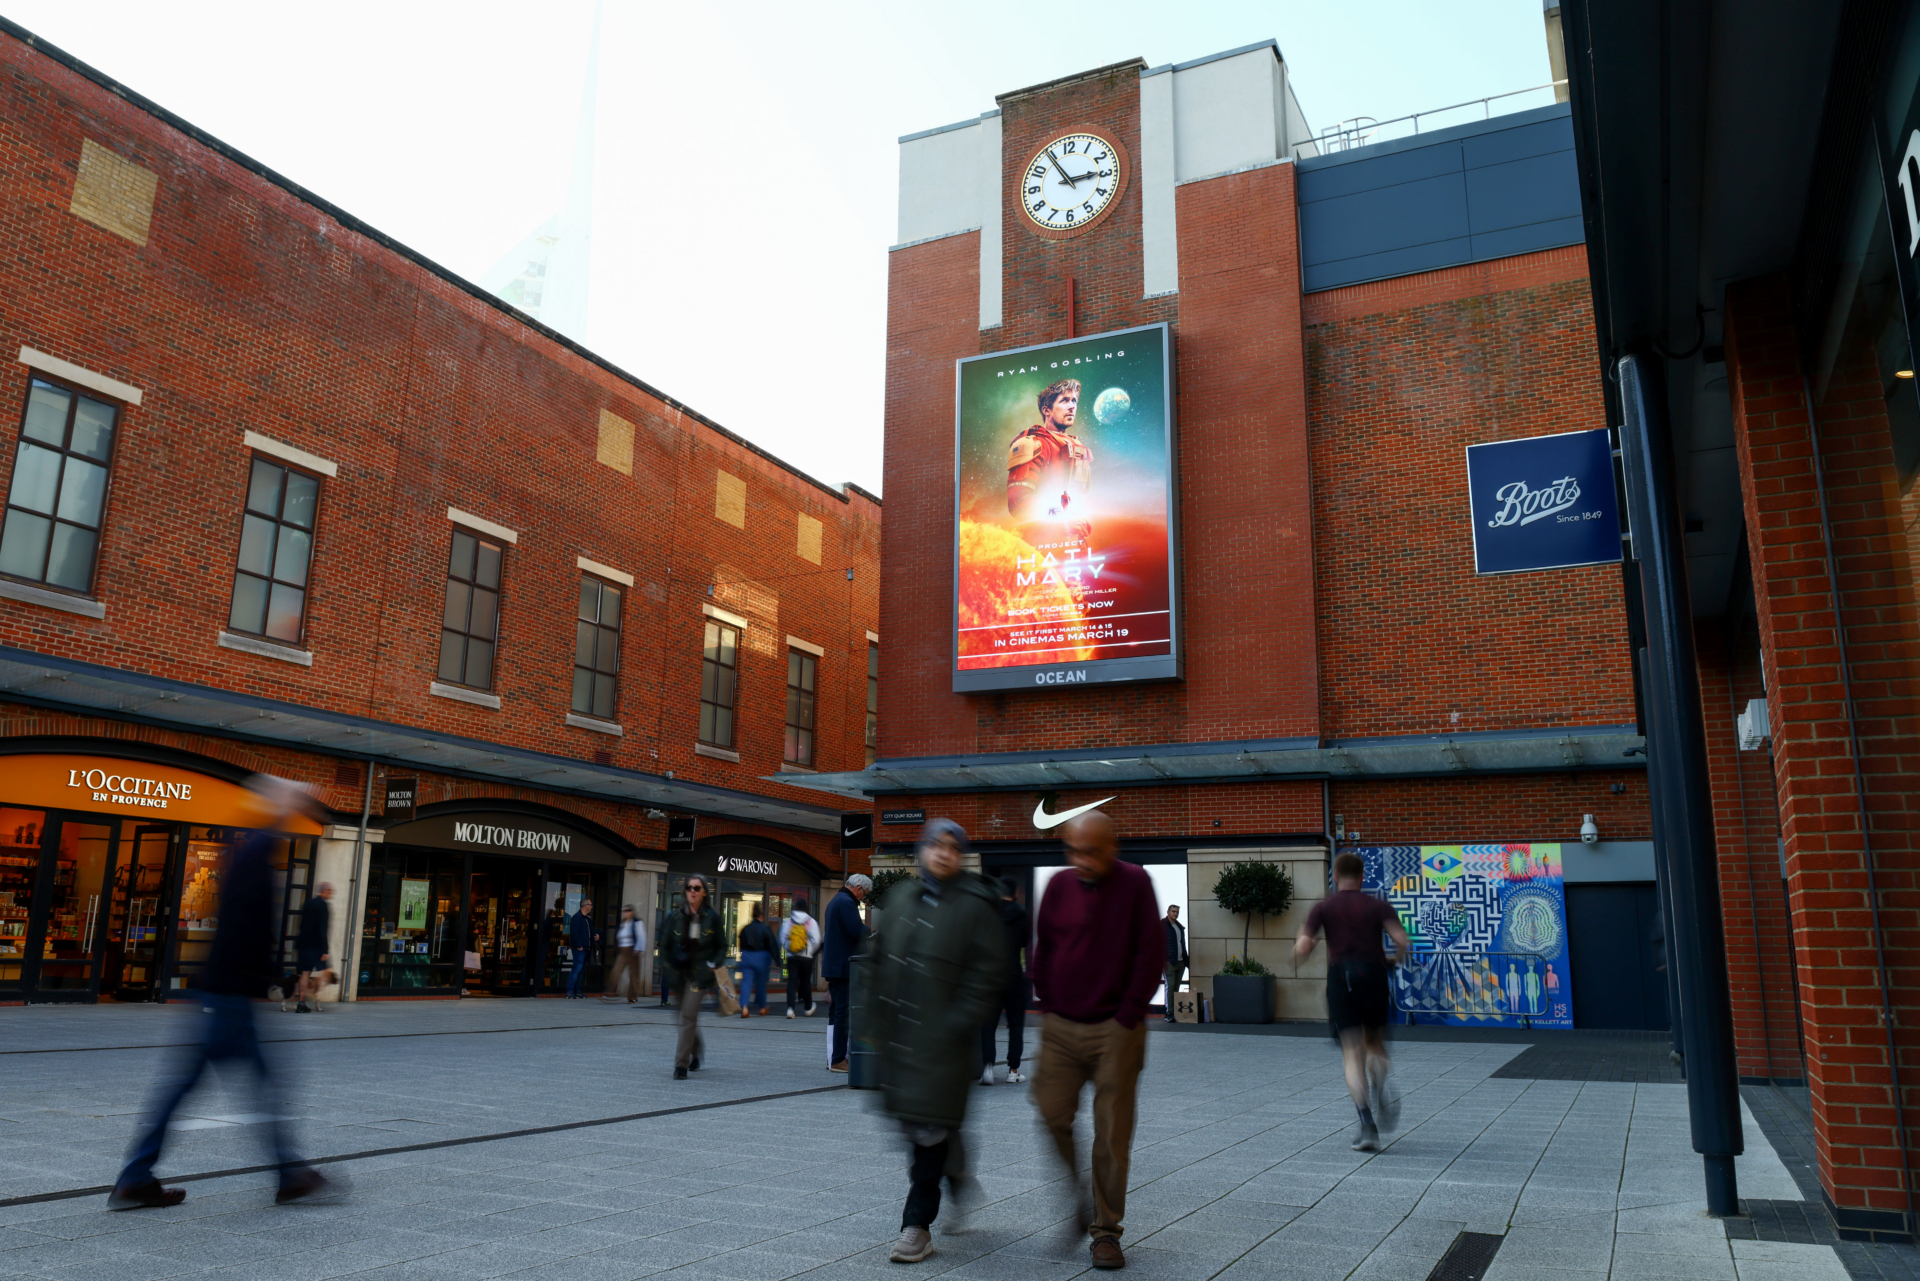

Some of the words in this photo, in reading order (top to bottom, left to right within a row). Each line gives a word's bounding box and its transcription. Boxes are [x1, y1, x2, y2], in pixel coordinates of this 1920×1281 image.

[1063, 141, 1075, 155] 12
[1083, 142, 1091, 154] 1
[1093, 151, 1107, 164] 2
[1031, 165, 1047, 178] 10
[1098, 168, 1112, 178] 3
[1028, 185, 1041, 195] 9
[1095, 187, 1108, 197] 4
[1033, 200, 1046, 212] 8
[1082, 201, 1094, 214] 5
[1047, 208, 1059, 221] 7
[1066, 209, 1074, 223] 6
[997, 365, 1038, 378] RYAN
[1050, 350, 1125, 369] GOSLING
[1488, 476, 1581, 528] Boots
[1556, 514, 1580, 523] Since
[1582, 510, 1602, 521] 1849
[1038, 539, 1084, 550] PROJECT
[1016, 547, 1106, 569] HAIL
[1016, 563, 1105, 587] MARY
[1007, 607, 1036, 617] BOOK
[1039, 603, 1085, 614] TICKETS
[1087, 600, 1114, 609] NOW
[1059, 625, 1088, 633] MARCH
[994, 639, 1006, 648] IN
[1009, 634, 1065, 646] CINEMAS
[1067, 630, 1114, 641] MARCH
[1116, 628, 1129, 637] 19
[1035, 669, 1086, 685] OCEAN
[67, 768, 192, 801] L'OCCITANE
[92, 792, 108, 802] EN
[111, 794, 168, 808] PROVENCE
[388, 791, 412, 799] MOLTON
[387, 799, 412, 808] BROWN
[453, 822, 515, 848] MOLTON
[516, 829, 571, 854] BROWN
[729, 857, 778, 876] SWAROVSKI
[1554, 1003, 1567, 1011] HS
[1554, 1010, 1568, 1018] DC
